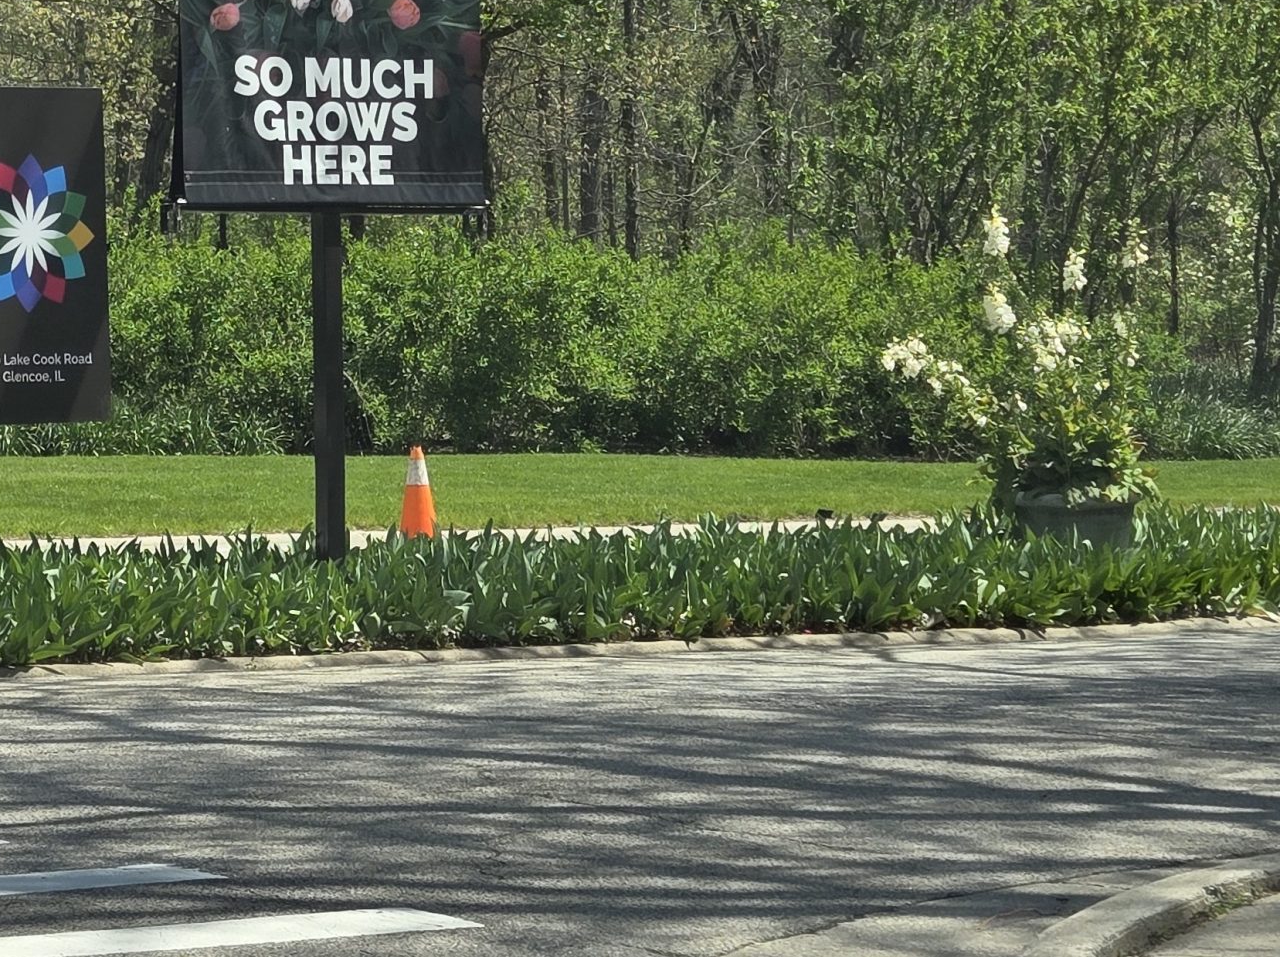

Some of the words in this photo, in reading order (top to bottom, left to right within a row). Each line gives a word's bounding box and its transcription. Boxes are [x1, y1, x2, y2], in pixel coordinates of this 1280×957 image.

[233, 54, 293, 98] SO
[304, 56, 434, 100] MUCH
[253, 99, 418, 142] GROWS
[282, 144, 395, 186] HERE
[2, 370, 52, 383] Glencoe,
[54, 369, 66, 382] IL
[3, 353, 31, 366] Lake
[32, 352, 62, 365] Cook
[63, 352, 93, 365] Road
